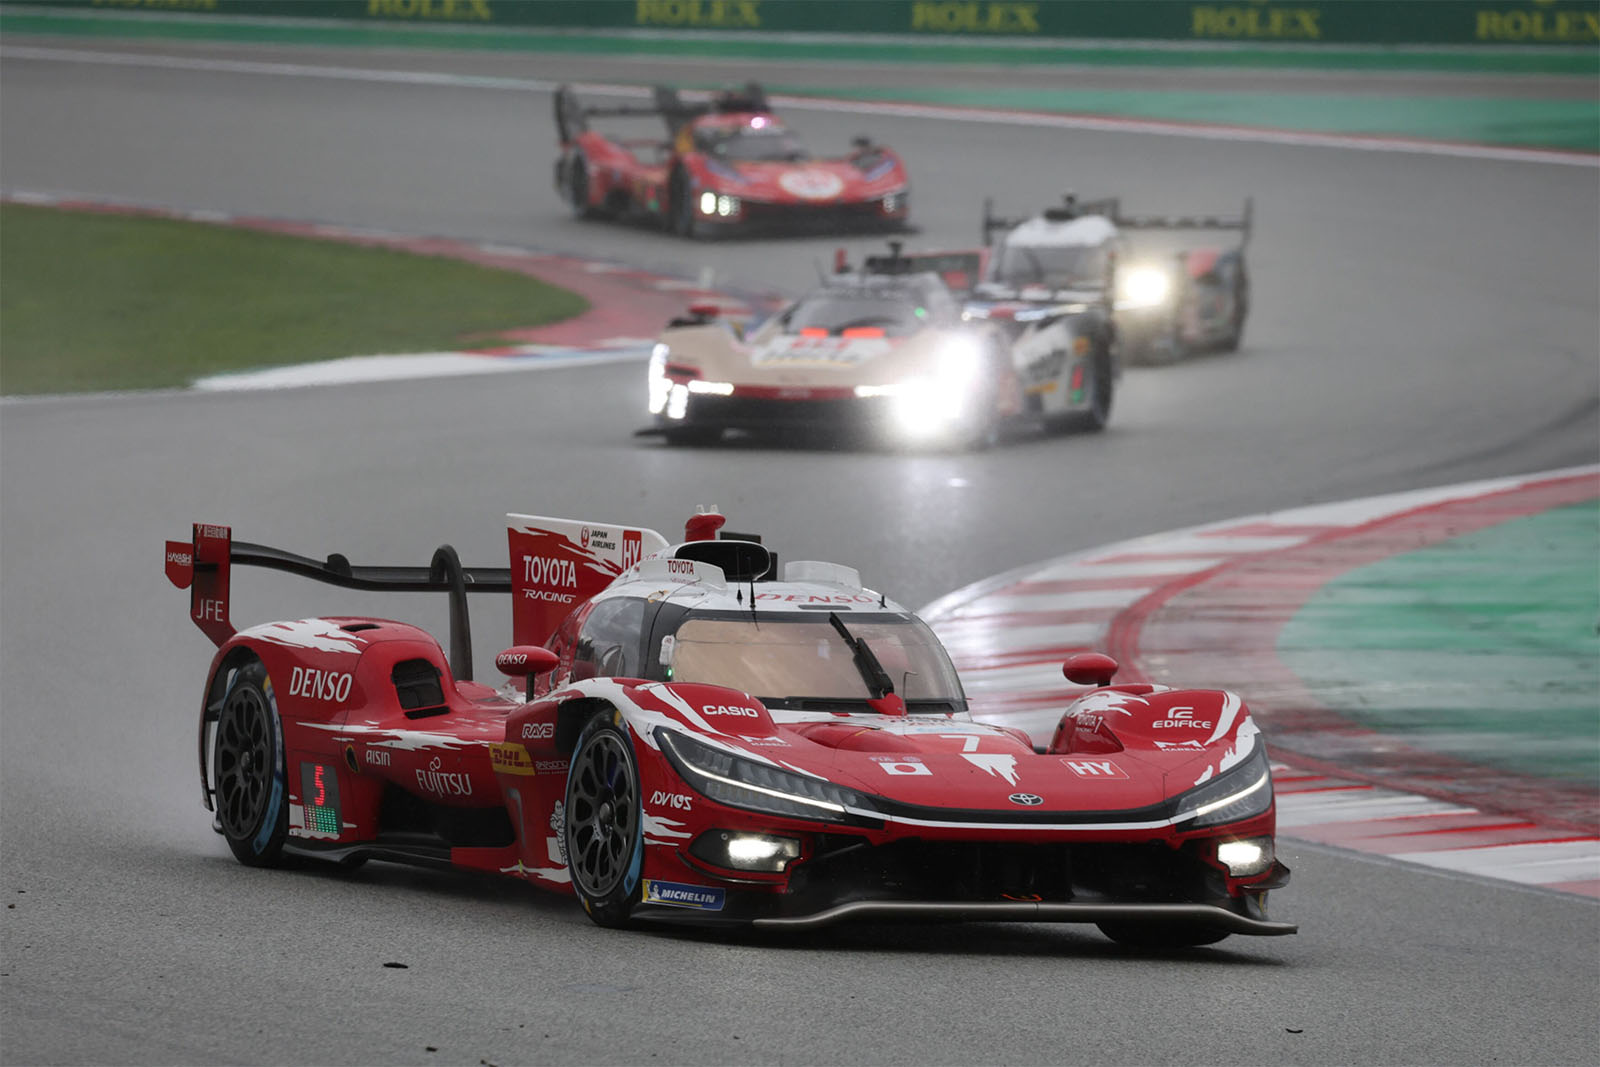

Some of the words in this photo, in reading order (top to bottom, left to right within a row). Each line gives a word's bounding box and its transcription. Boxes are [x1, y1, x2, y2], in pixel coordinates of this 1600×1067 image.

[911, 3, 1039, 33] ROLEX
[1192, 8, 1321, 39] ROLEX
[591, 530, 608, 539] JAPAN
[592, 540, 616, 551] AIRLINES
[523, 555, 577, 588] TOYOTA
[667, 560, 695, 575] TOYOTA
[522, 588, 577, 604] RACING
[755, 593, 873, 603] DENSO
[196, 599, 224, 622] JFE
[497, 653, 528, 665] DENSO
[289, 666, 353, 703] DENSO
[702, 705, 759, 718] CASIO
[522, 723, 555, 739] RAYS
[1152, 720, 1212, 729] EDIFICE
[939, 735, 981, 753] 7
[366, 750, 391, 767] AISIN
[492, 748, 526, 767] DHL
[1067, 761, 1115, 775] HY
[415, 768, 473, 799] FUJITSU
[661, 889, 716, 904] MICHELIN
